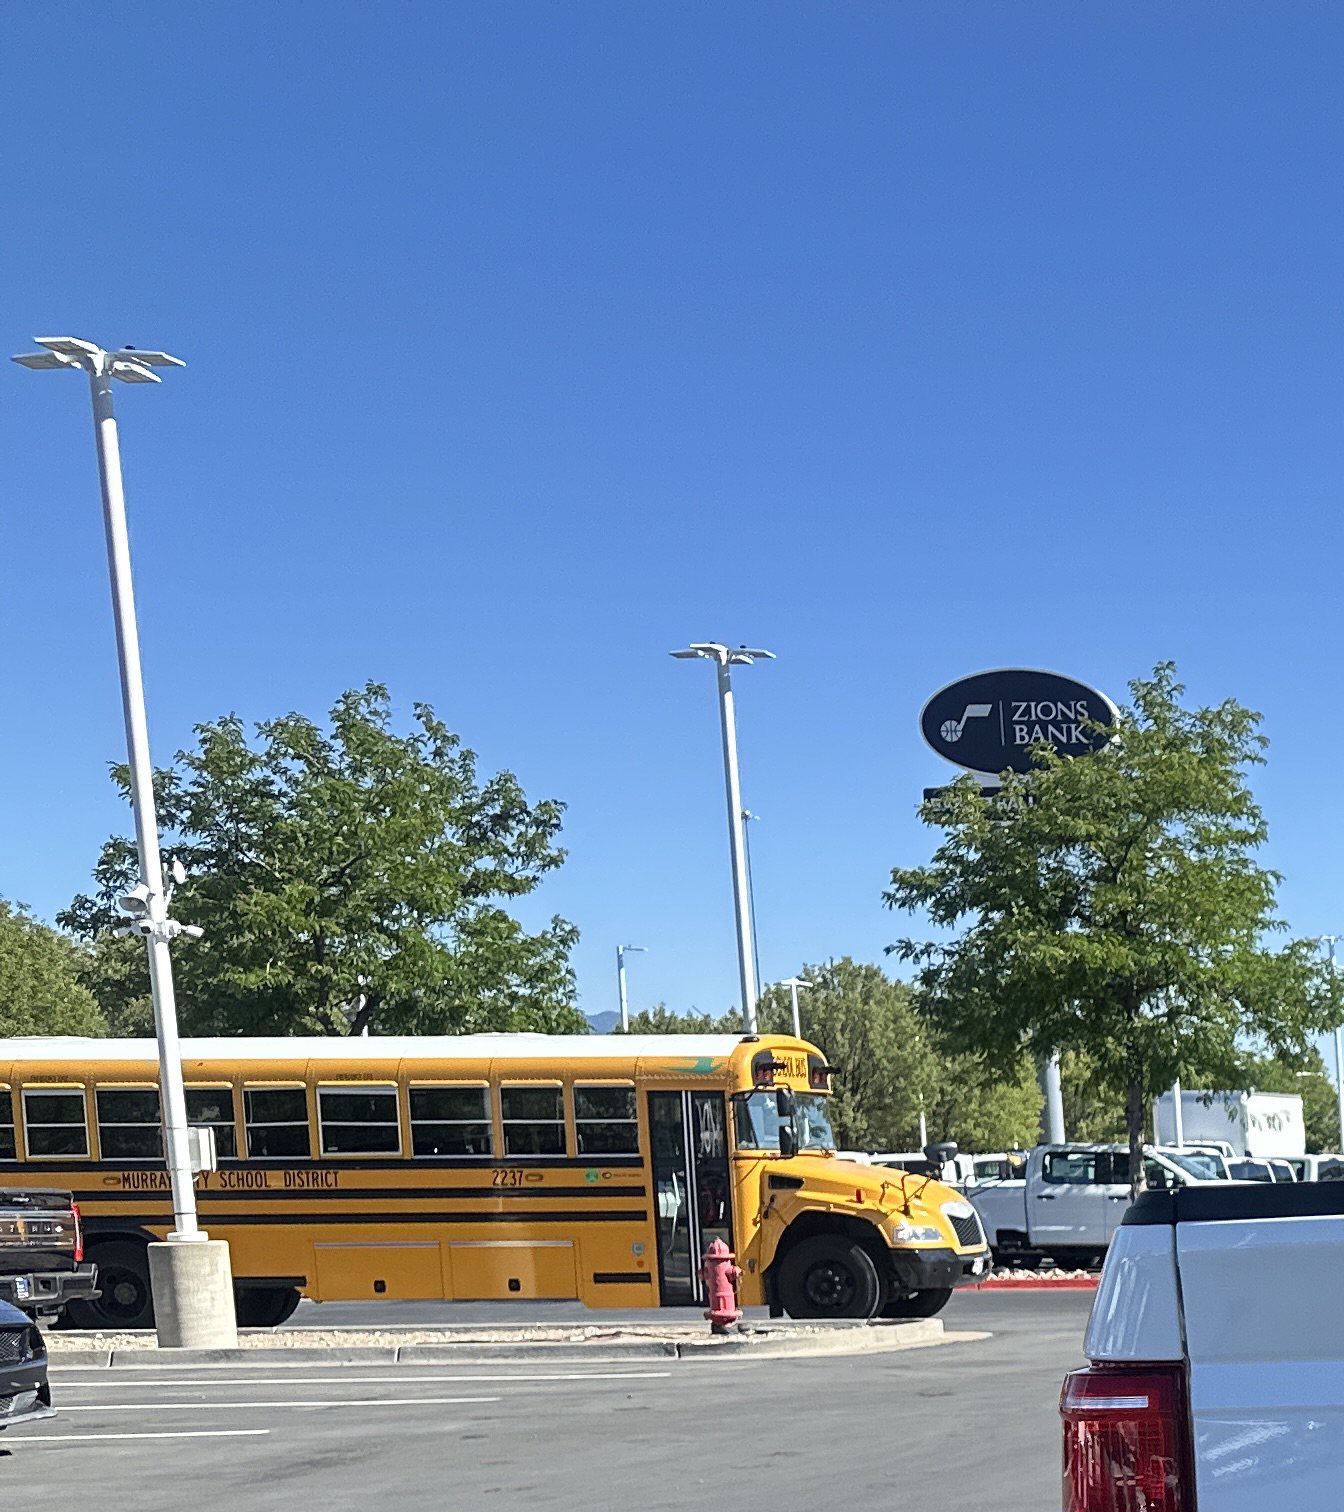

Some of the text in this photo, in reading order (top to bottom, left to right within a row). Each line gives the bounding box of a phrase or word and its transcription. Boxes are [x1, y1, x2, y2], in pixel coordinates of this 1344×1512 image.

[1011, 700, 1089, 722] ZIONS
[1013, 723, 1091, 745] BANK
[220, 1171, 271, 1188] SCHOOL
[284, 1170, 340, 1187] DISTRICT
[492, 1169, 524, 1186] 2237
